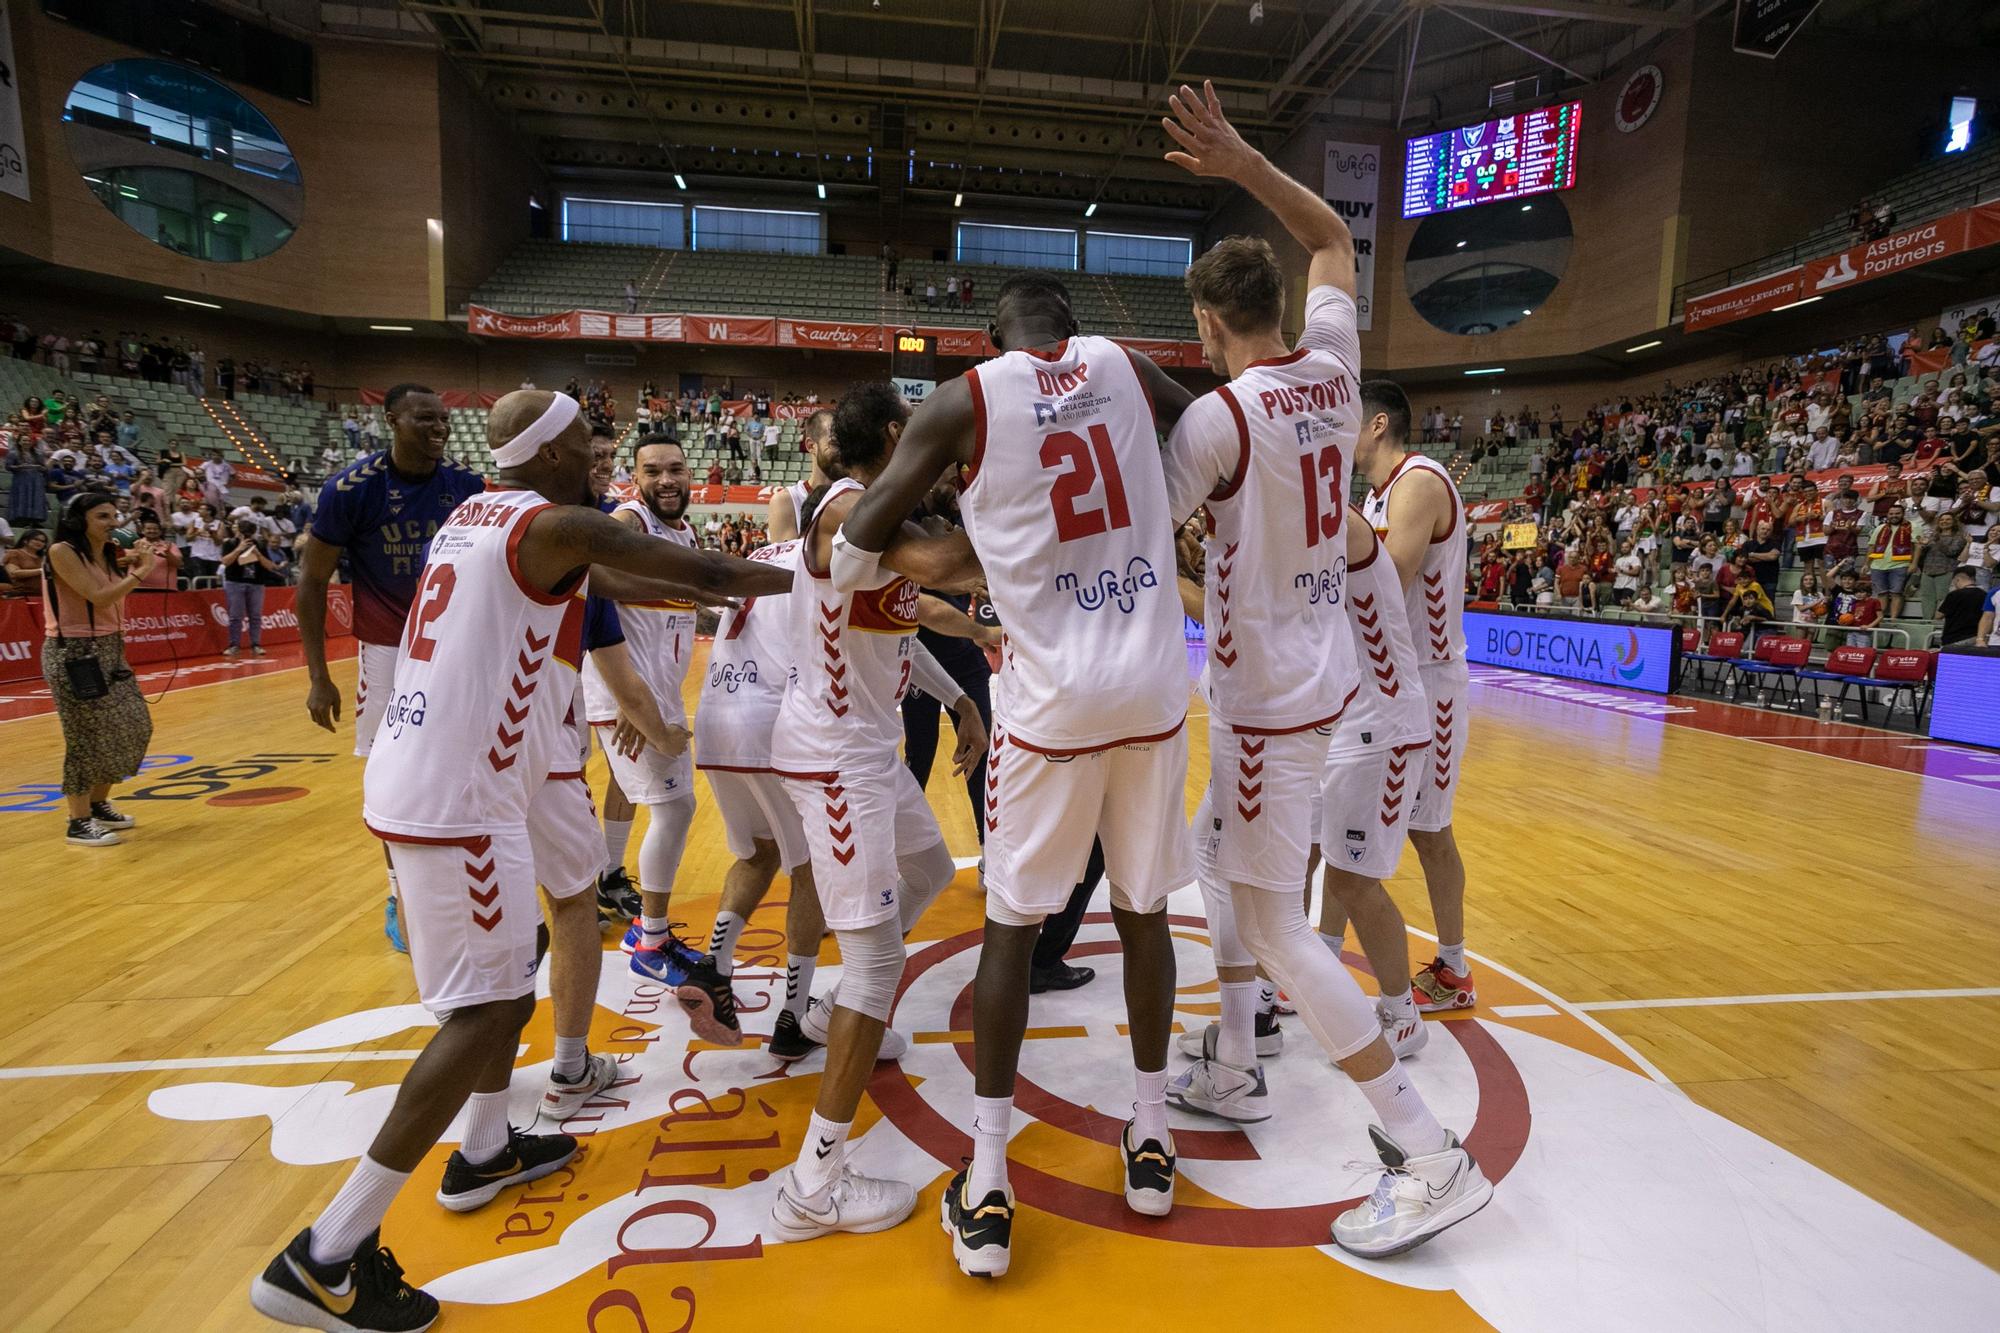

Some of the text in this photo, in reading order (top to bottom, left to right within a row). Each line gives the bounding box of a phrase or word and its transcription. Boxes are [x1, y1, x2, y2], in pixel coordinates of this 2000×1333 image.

[1461, 152, 1482, 168] 67
[1476, 163, 1497, 177] 0.0
[1494, 145, 1515, 161] 55
[1864, 240, 1945, 276] Partners
[1866, 224, 1937, 259] Asterra
[1701, 299, 1743, 316] ESTRELLA
[497, 319, 570, 333] CaixaBank
[1035, 362, 1088, 396] DIOP
[1078, 400, 1094, 409] CRUZ
[1095, 396, 1111, 405] 2024
[1259, 375, 1351, 419] PUSTOVYI
[1039, 424, 1132, 543] 21
[1300, 444, 1342, 548] 13
[381, 520, 440, 543] UCA
[408, 563, 457, 662] 12
[1487, 628, 1603, 669] BIOTECNA
